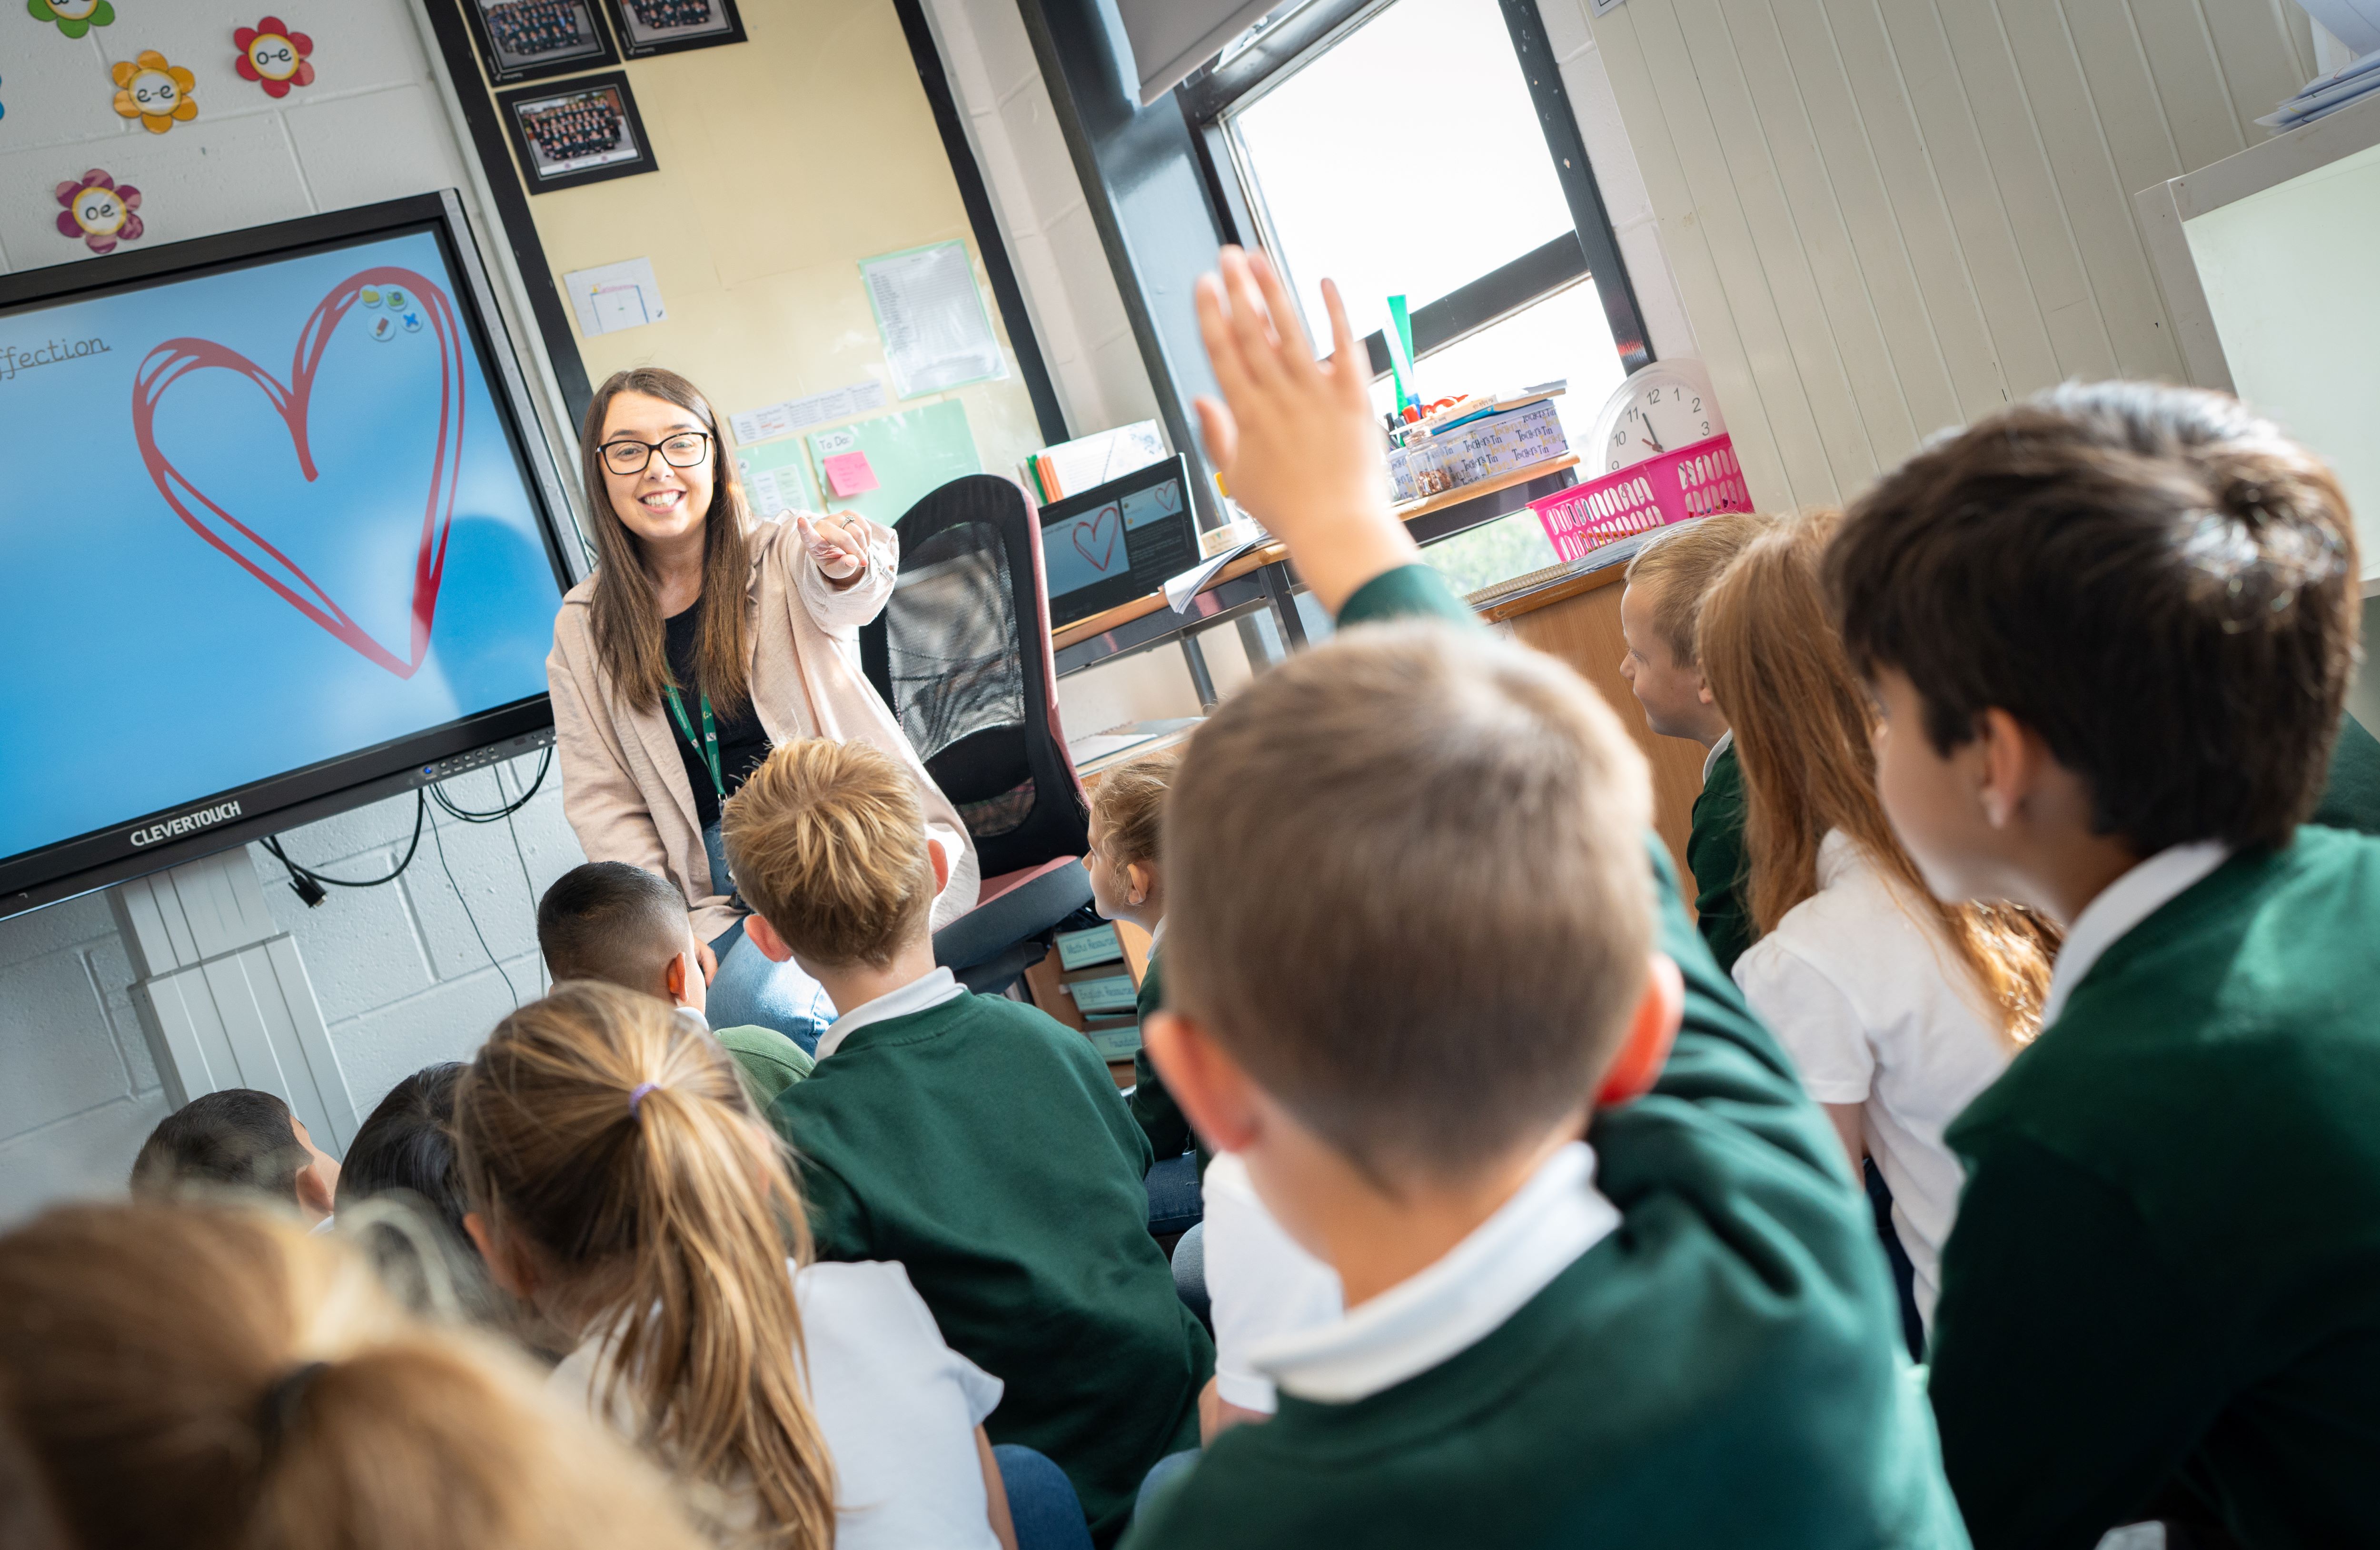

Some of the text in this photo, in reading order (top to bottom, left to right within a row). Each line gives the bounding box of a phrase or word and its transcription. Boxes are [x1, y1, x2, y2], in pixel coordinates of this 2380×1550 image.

[257, 49, 292, 65] o-e
[137, 85, 174, 102] e-e
[86, 204, 114, 220] oe
[0, 337, 111, 380] fection
[1646, 388, 1660, 405] 12
[1674, 387, 1680, 401] 1
[1692, 397, 1701, 413] 2
[1627, 406, 1638, 423] 11
[1541, 425, 1553, 436] Tin
[1701, 421, 1710, 436] 3
[819, 439, 833, 450] To
[1490, 434, 1502, 445] Tin
[1613, 431, 1626, 447] 10
[1537, 444, 1549, 455] Tin
[1486, 454, 1498, 464] Tin
[1611, 460, 1619, 470] 9
[130, 800, 242, 847] CLEVERTOUCH
